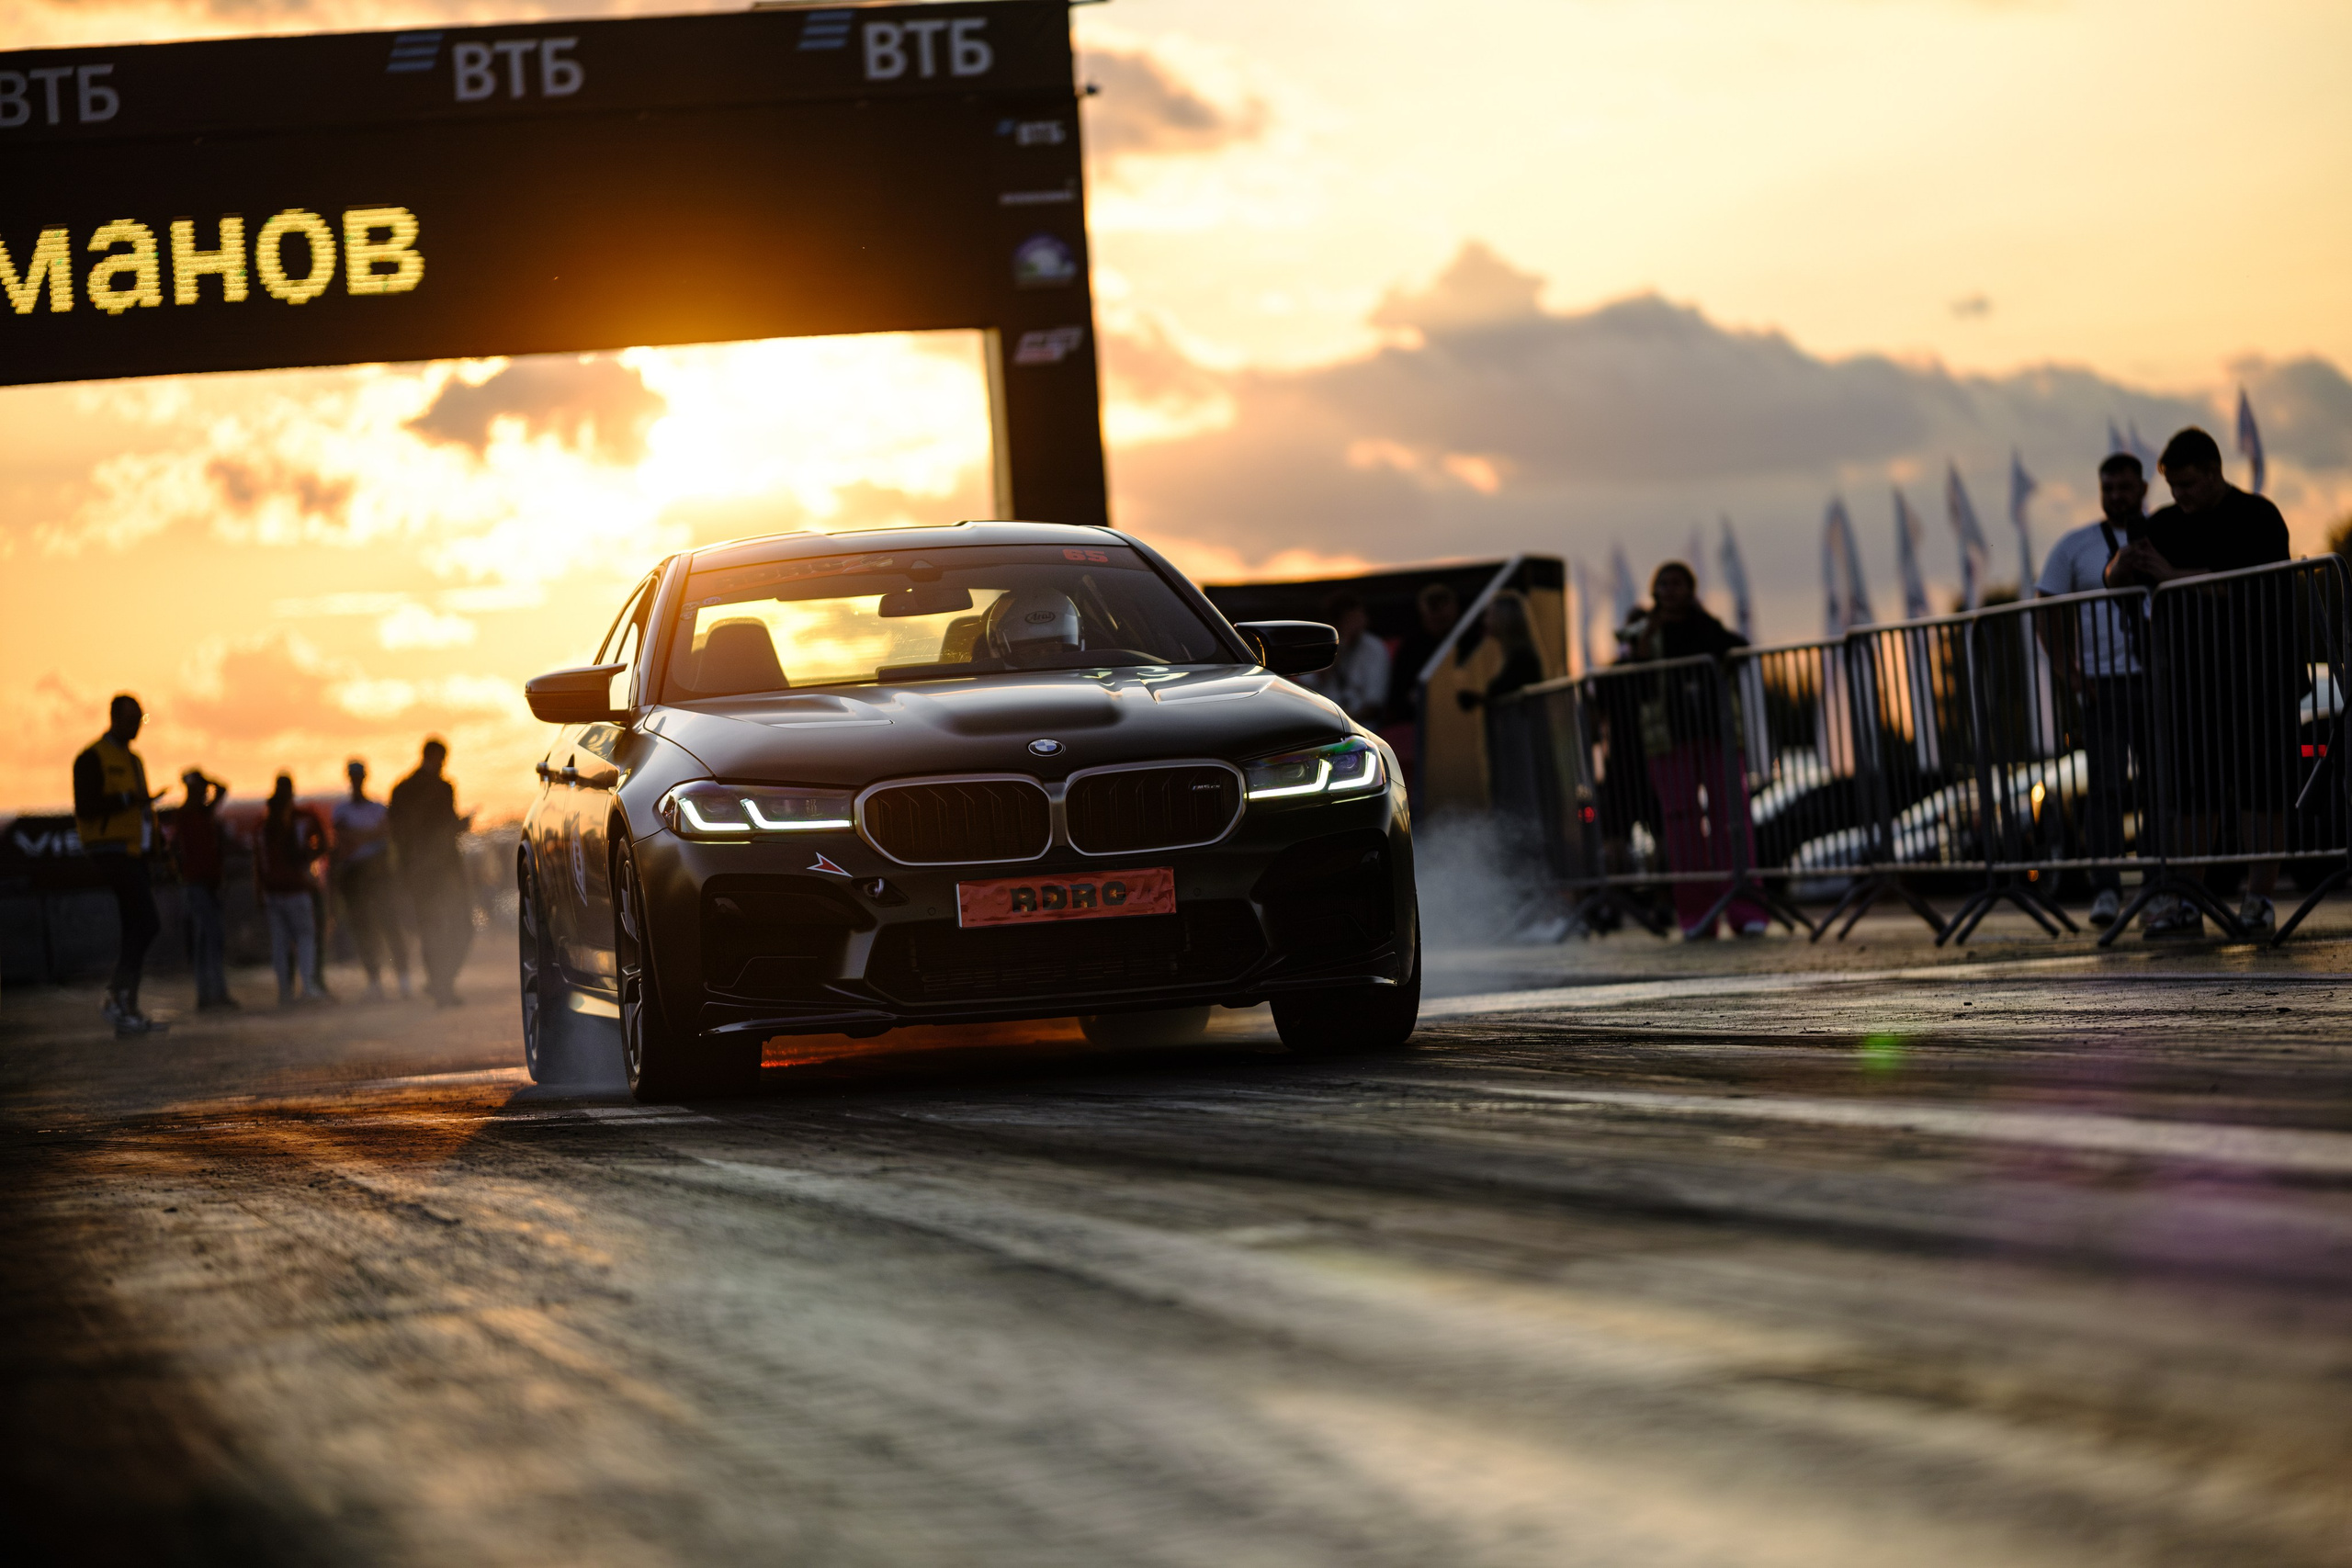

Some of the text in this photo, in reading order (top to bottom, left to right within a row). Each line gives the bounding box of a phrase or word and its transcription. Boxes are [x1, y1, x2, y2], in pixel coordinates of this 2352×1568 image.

[452, 37, 585, 101] ВТБ
[863, 17, 993, 80] ВТБ
[0, 63, 120, 128] ВТБ
